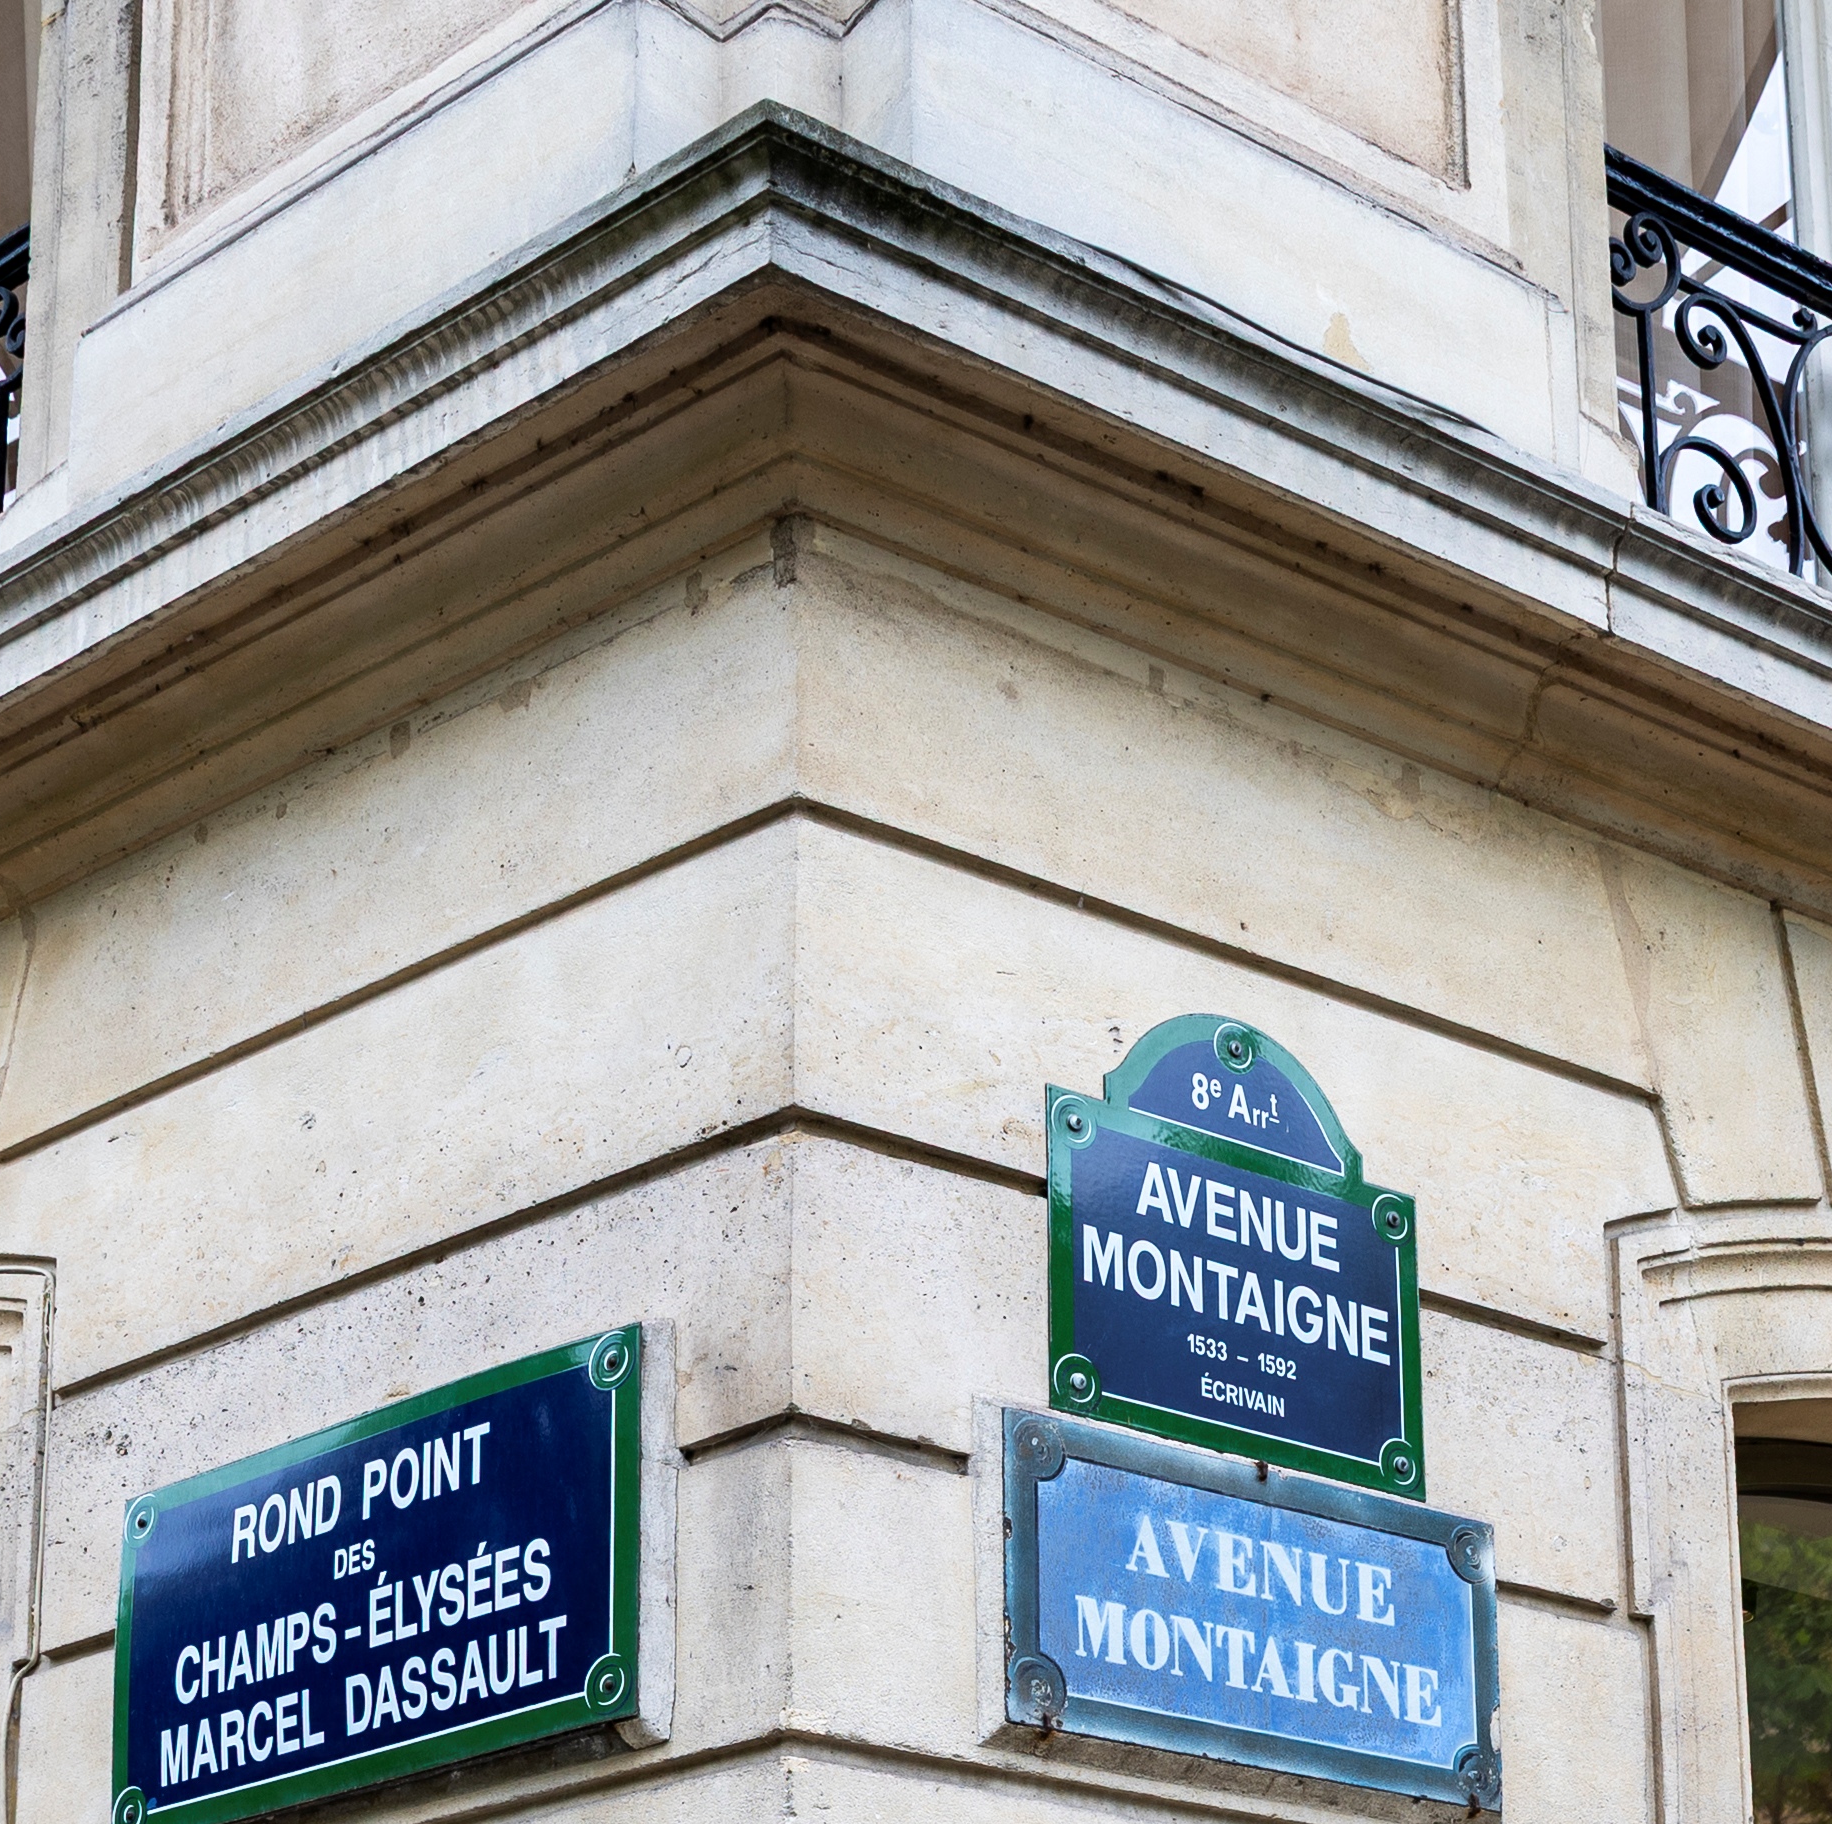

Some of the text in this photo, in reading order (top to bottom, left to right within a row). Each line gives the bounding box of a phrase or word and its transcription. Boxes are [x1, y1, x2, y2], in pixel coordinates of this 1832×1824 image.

[1135, 1161, 1340, 1273] AVENUE
[1082, 1223, 1391, 1366] MONTAIGNE
[1187, 1333, 1228, 1362] 1533
[1257, 1352, 1297, 1380] 1592
[1201, 1371, 1285, 1418] ÉCRIVAIN
[231, 1421, 491, 1564] ROND POINT
[334, 1538, 376, 1580] DES
[1125, 1514, 1395, 1627] AVENUE
[160, 1614, 568, 1788] MARCEL DASSAULT
[1074, 1594, 1442, 1728] MONTAIGNE
